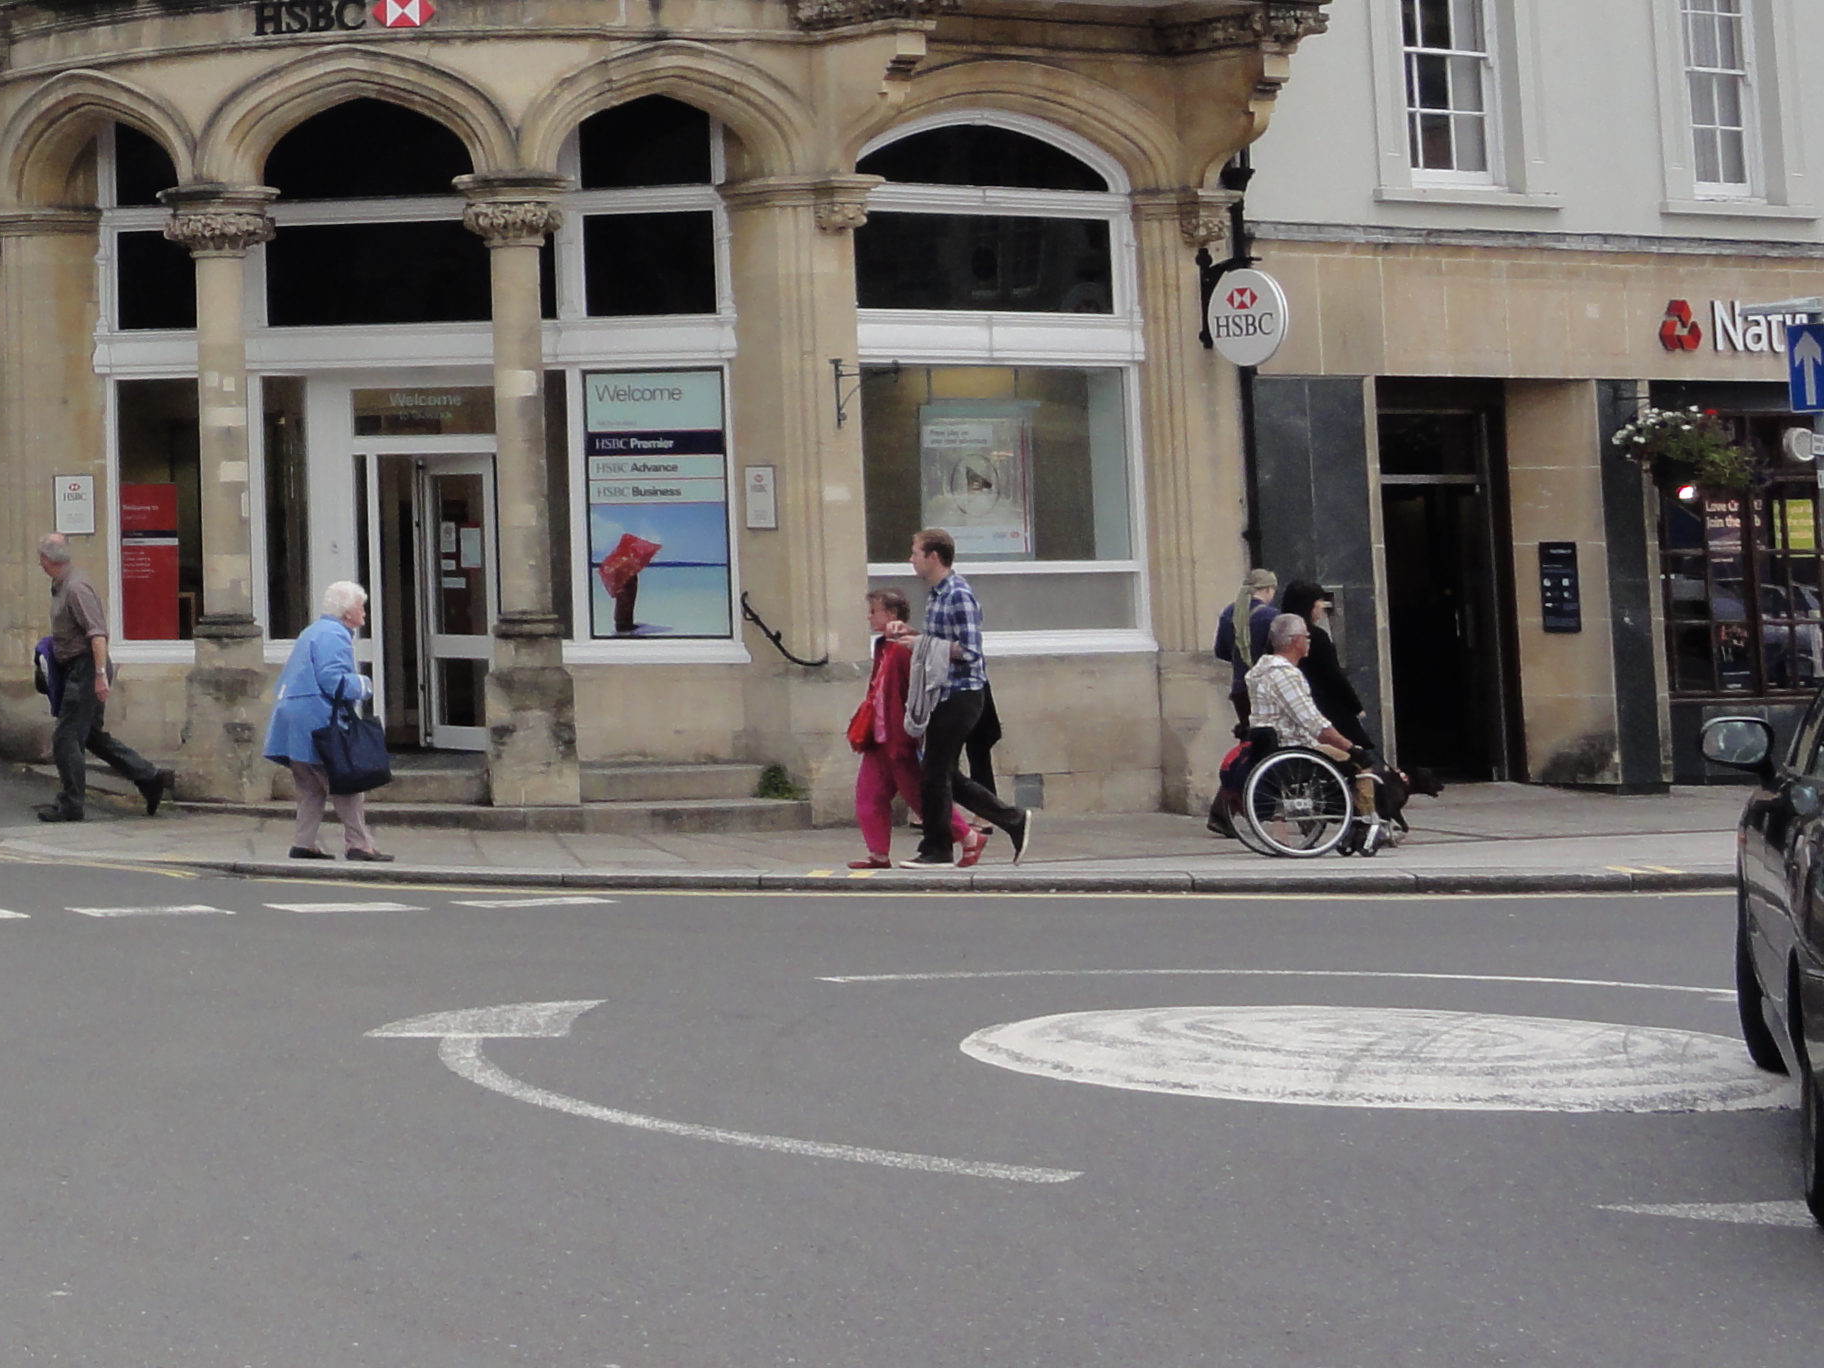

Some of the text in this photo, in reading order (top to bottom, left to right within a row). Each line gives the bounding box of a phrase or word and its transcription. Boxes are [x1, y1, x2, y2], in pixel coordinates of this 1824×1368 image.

[1214, 312, 1275, 339] HSBC
[389, 393, 462, 407] Welcome
[595, 384, 683, 403] Welcome
[596, 437, 674, 449] HSBC Premier
[596, 462, 678, 473] HSBC Advance
[63, 492, 87, 501] HSBC
[597, 485, 682, 497] HSBC Business
[1725, 514, 1741, 528] the
